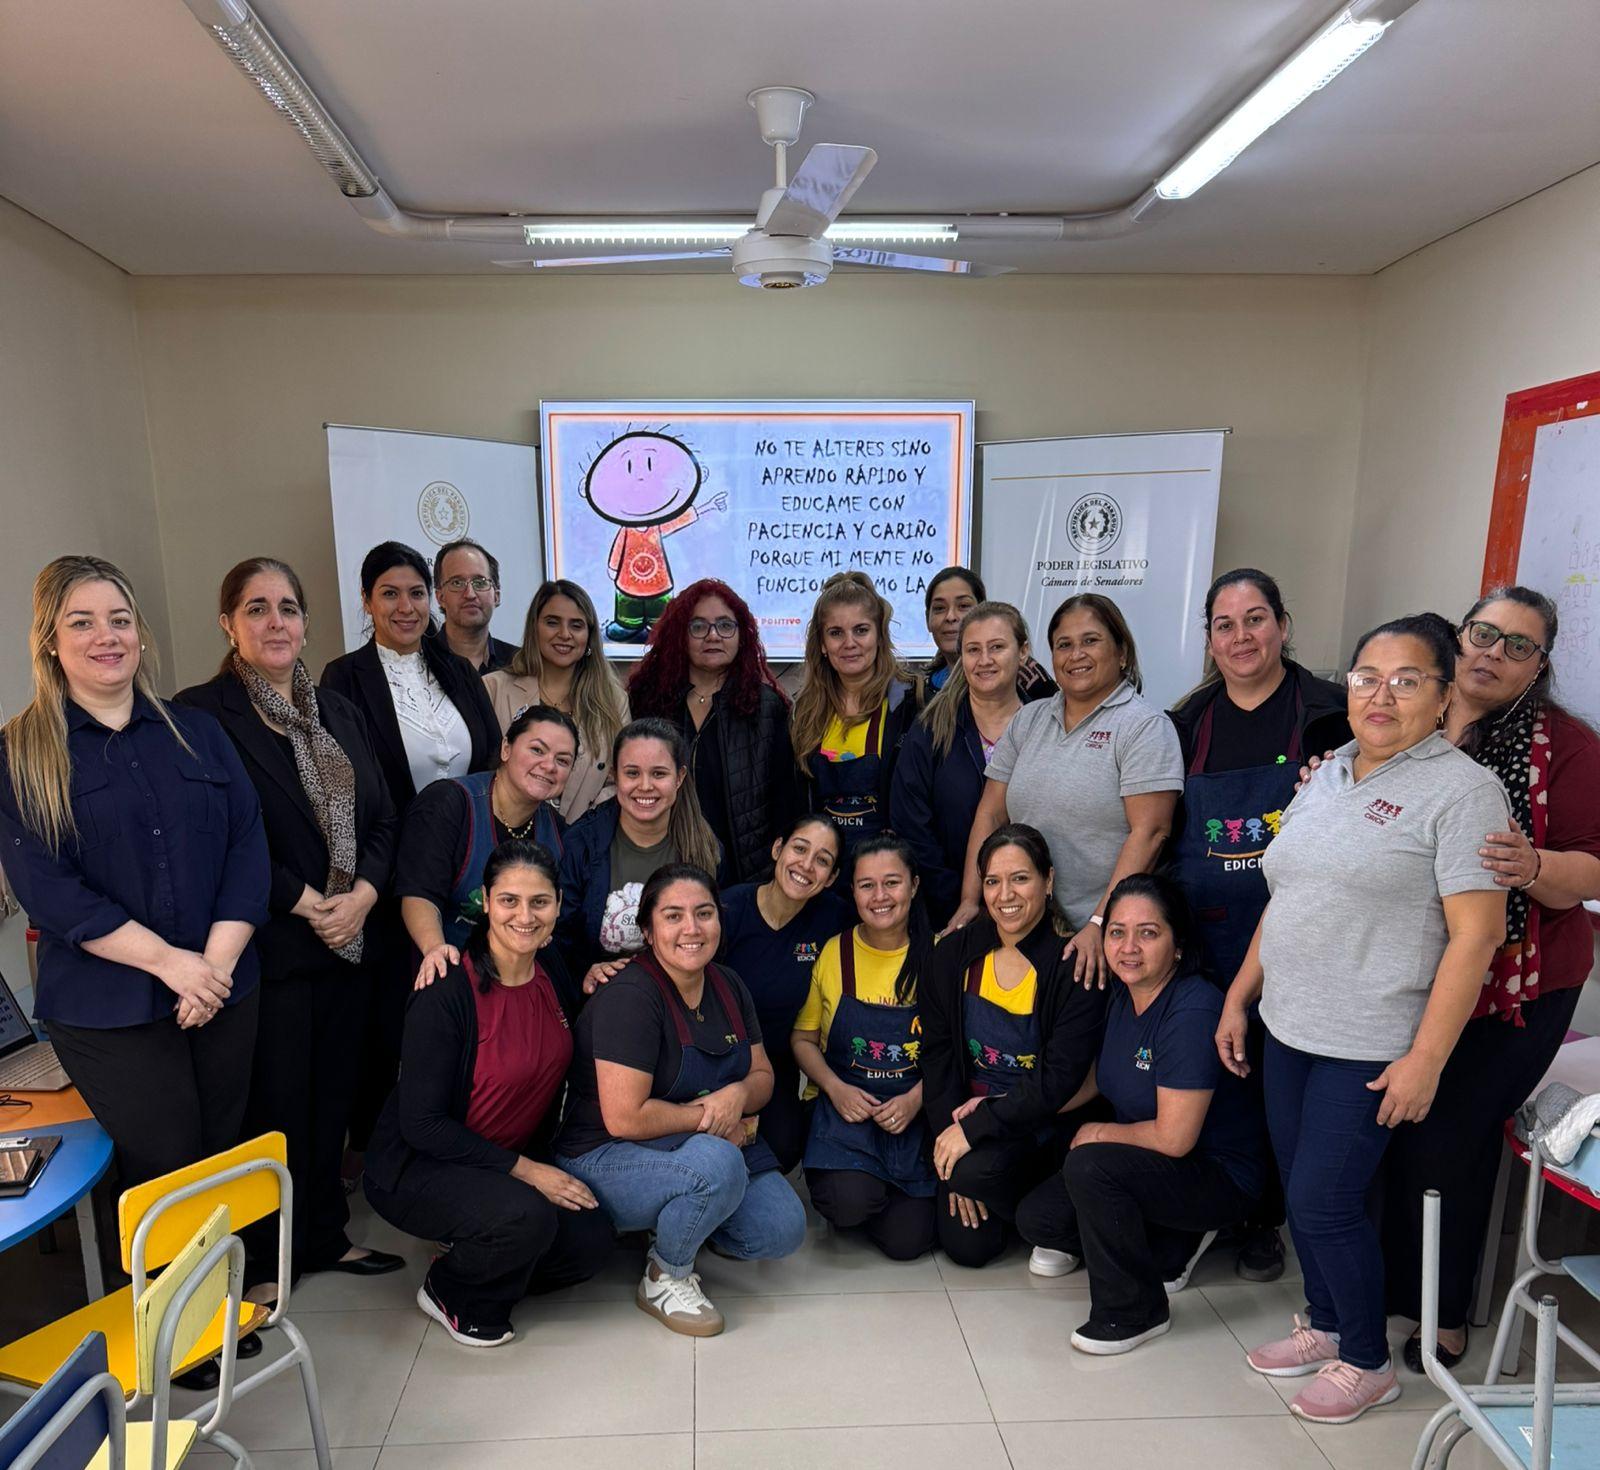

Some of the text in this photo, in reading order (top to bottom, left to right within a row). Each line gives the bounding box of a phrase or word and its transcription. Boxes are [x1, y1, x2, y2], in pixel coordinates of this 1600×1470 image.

[754, 438, 931, 459] NO TE ALTERES SINO
[761, 463, 927, 486] APRENDO RÁPIDO Y
[782, 494, 906, 514] EDUCAME CON
[748, 519, 937, 541] PACIENCIA Y CARIÑO
[750, 549, 934, 569] PORQUE MI MENTE NO
[1037, 559, 1149, 571] PODER LEGISLATIVO
[905, 575, 928, 595] LA
[1041, 576, 1144, 588] Cámara de Senadores
[867, 1070, 904, 1080] EDICN
